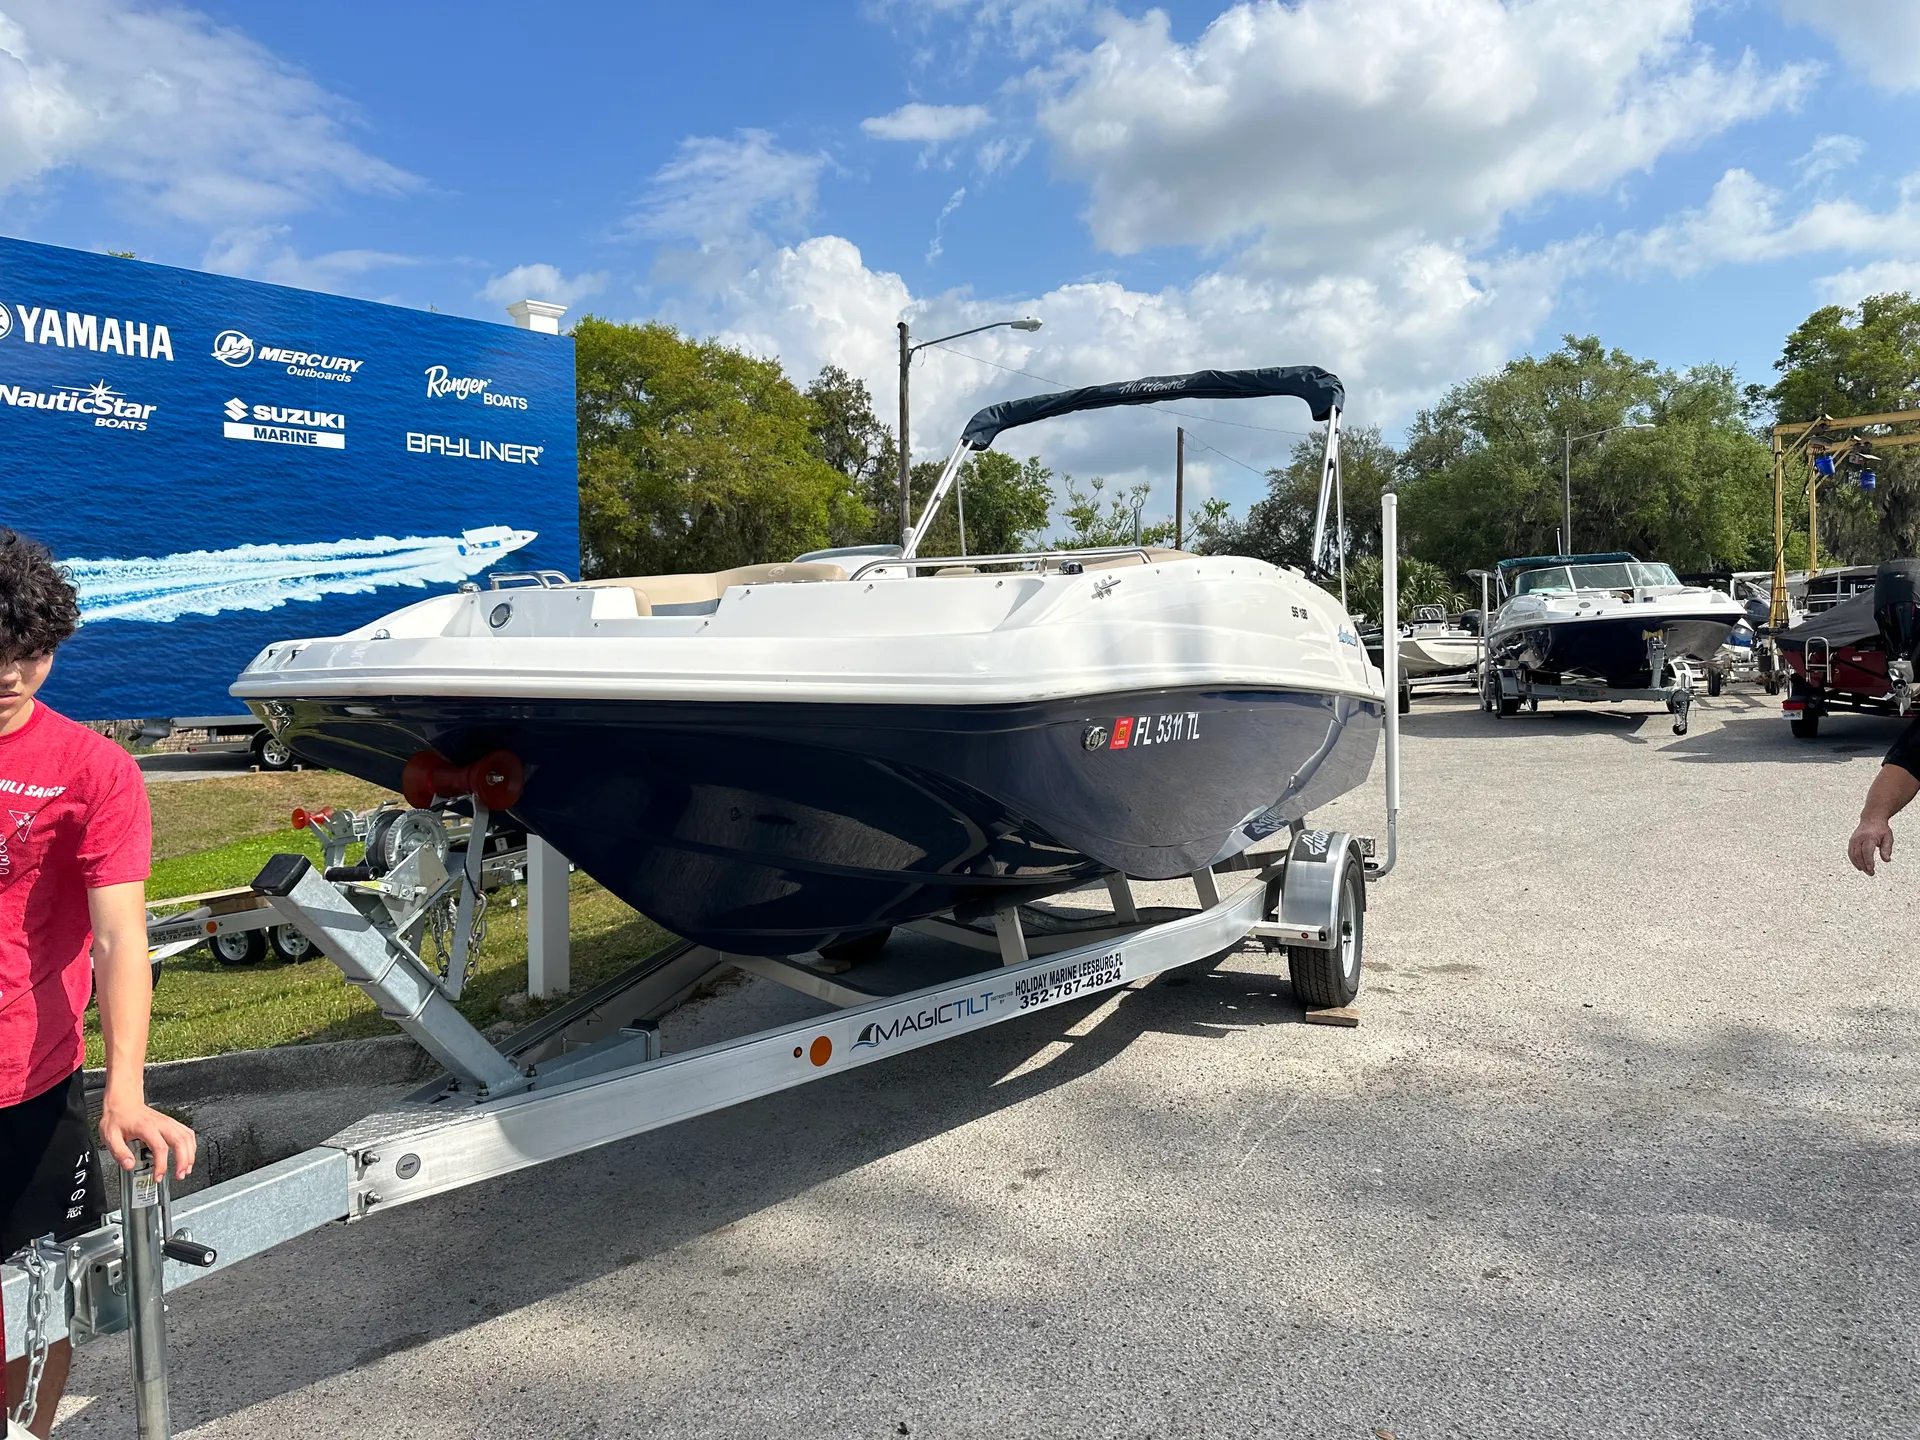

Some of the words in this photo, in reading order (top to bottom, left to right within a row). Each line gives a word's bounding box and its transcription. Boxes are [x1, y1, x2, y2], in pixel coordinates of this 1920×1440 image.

[16, 304, 174, 361] YAMAHA
[258, 346, 364, 373] MERCURY
[286, 365, 352, 383] Outboards
[425, 365, 488, 400] Ranger
[1119, 379, 1187, 395] Hurricane
[0, 384, 157, 419] NauticStar
[483, 392, 528, 410] BOATS
[95, 417, 147, 431] BOATS
[253, 404, 345, 429] SUZUKI
[253, 426, 318, 444] MARINE
[406, 431, 539, 466] BAYLINER
[1133, 716, 1152, 746] FL
[1155, 713, 1184, 744] 5311
[1187, 711, 1200, 740] TL
[1015, 975, 1048, 997] HOLIDAY
[1049, 964, 1078, 986] MARINE
[1019, 967, 1122, 1010] 352-787-4824
